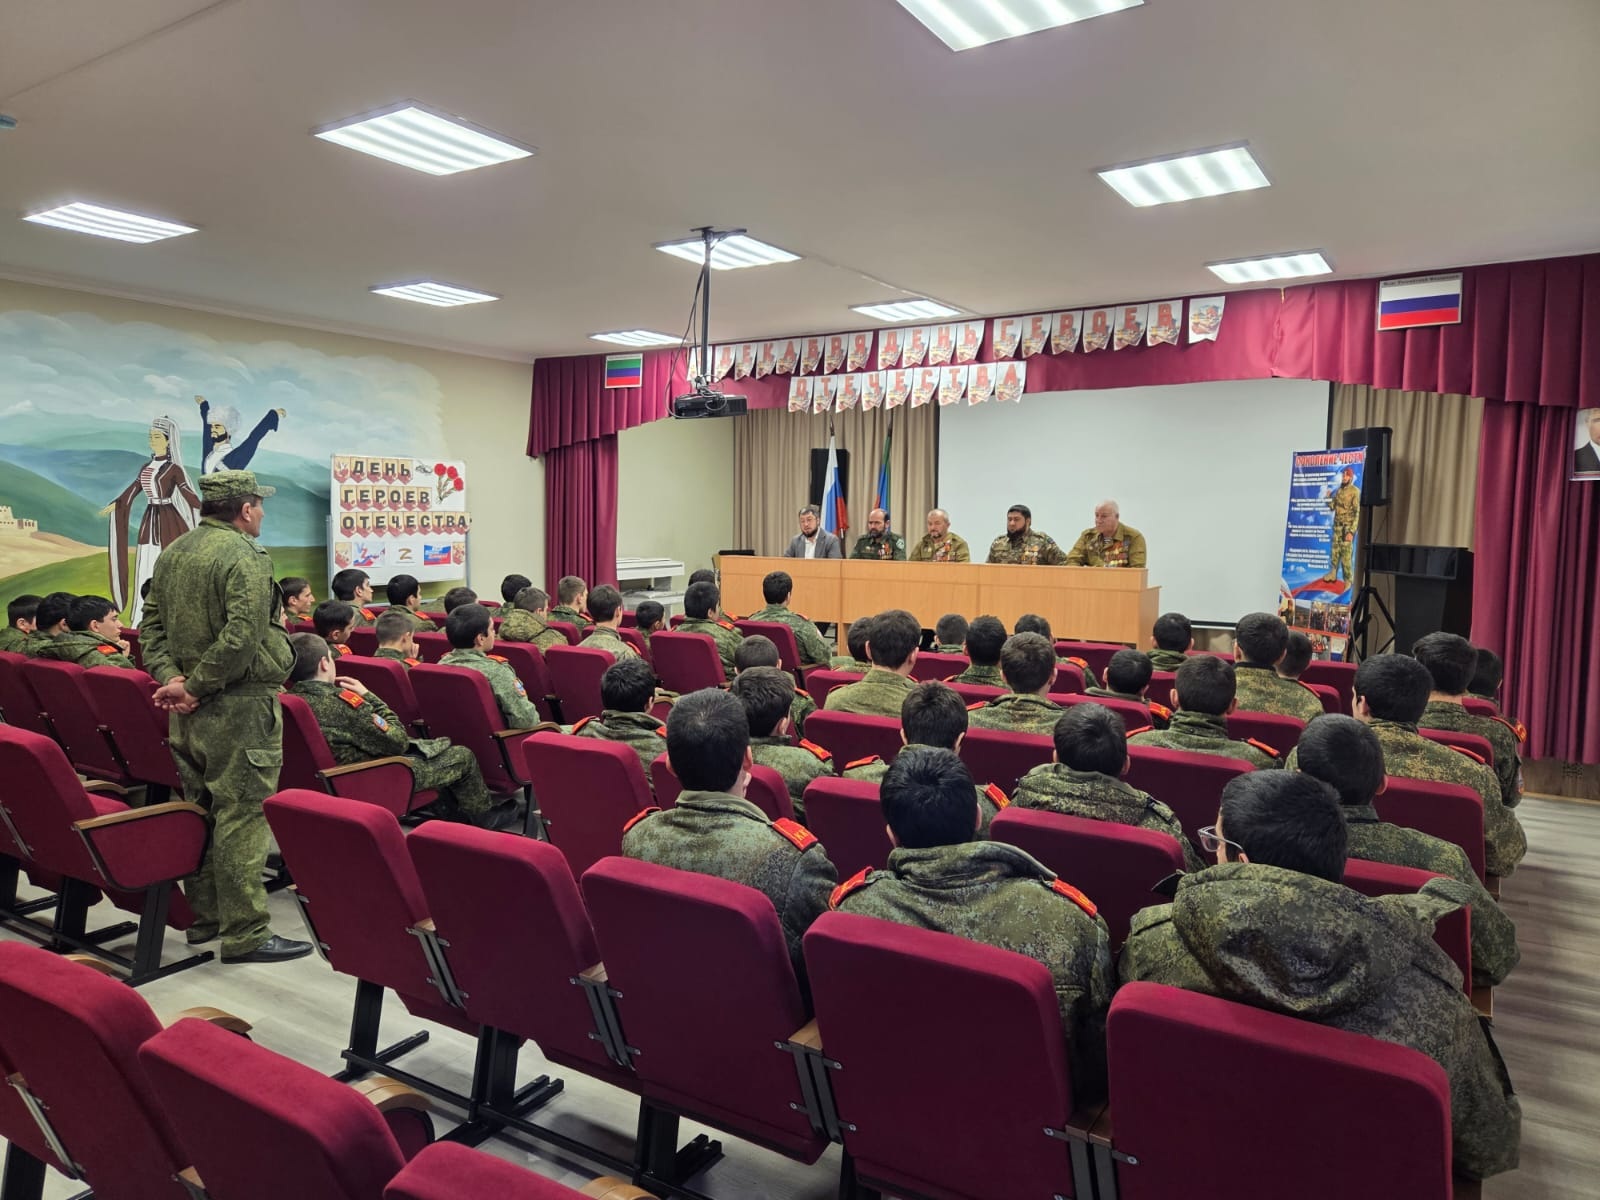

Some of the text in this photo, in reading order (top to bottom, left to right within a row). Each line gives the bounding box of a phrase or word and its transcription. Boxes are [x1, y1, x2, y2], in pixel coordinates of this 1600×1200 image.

[720, 334, 867, 366] ДЕКАБРЯ
[884, 323, 977, 352] ДЕНЬ
[1000, 303, 1174, 341] ГЕРОЕВ
[796, 364, 1018, 398] ОТЕЧЕСТВА
[353, 461, 410, 477] ДЕНЬ
[344, 489, 430, 504] ГЕРОЕВ
[342, 515, 466, 529] ОТЕЧЕСТВА
